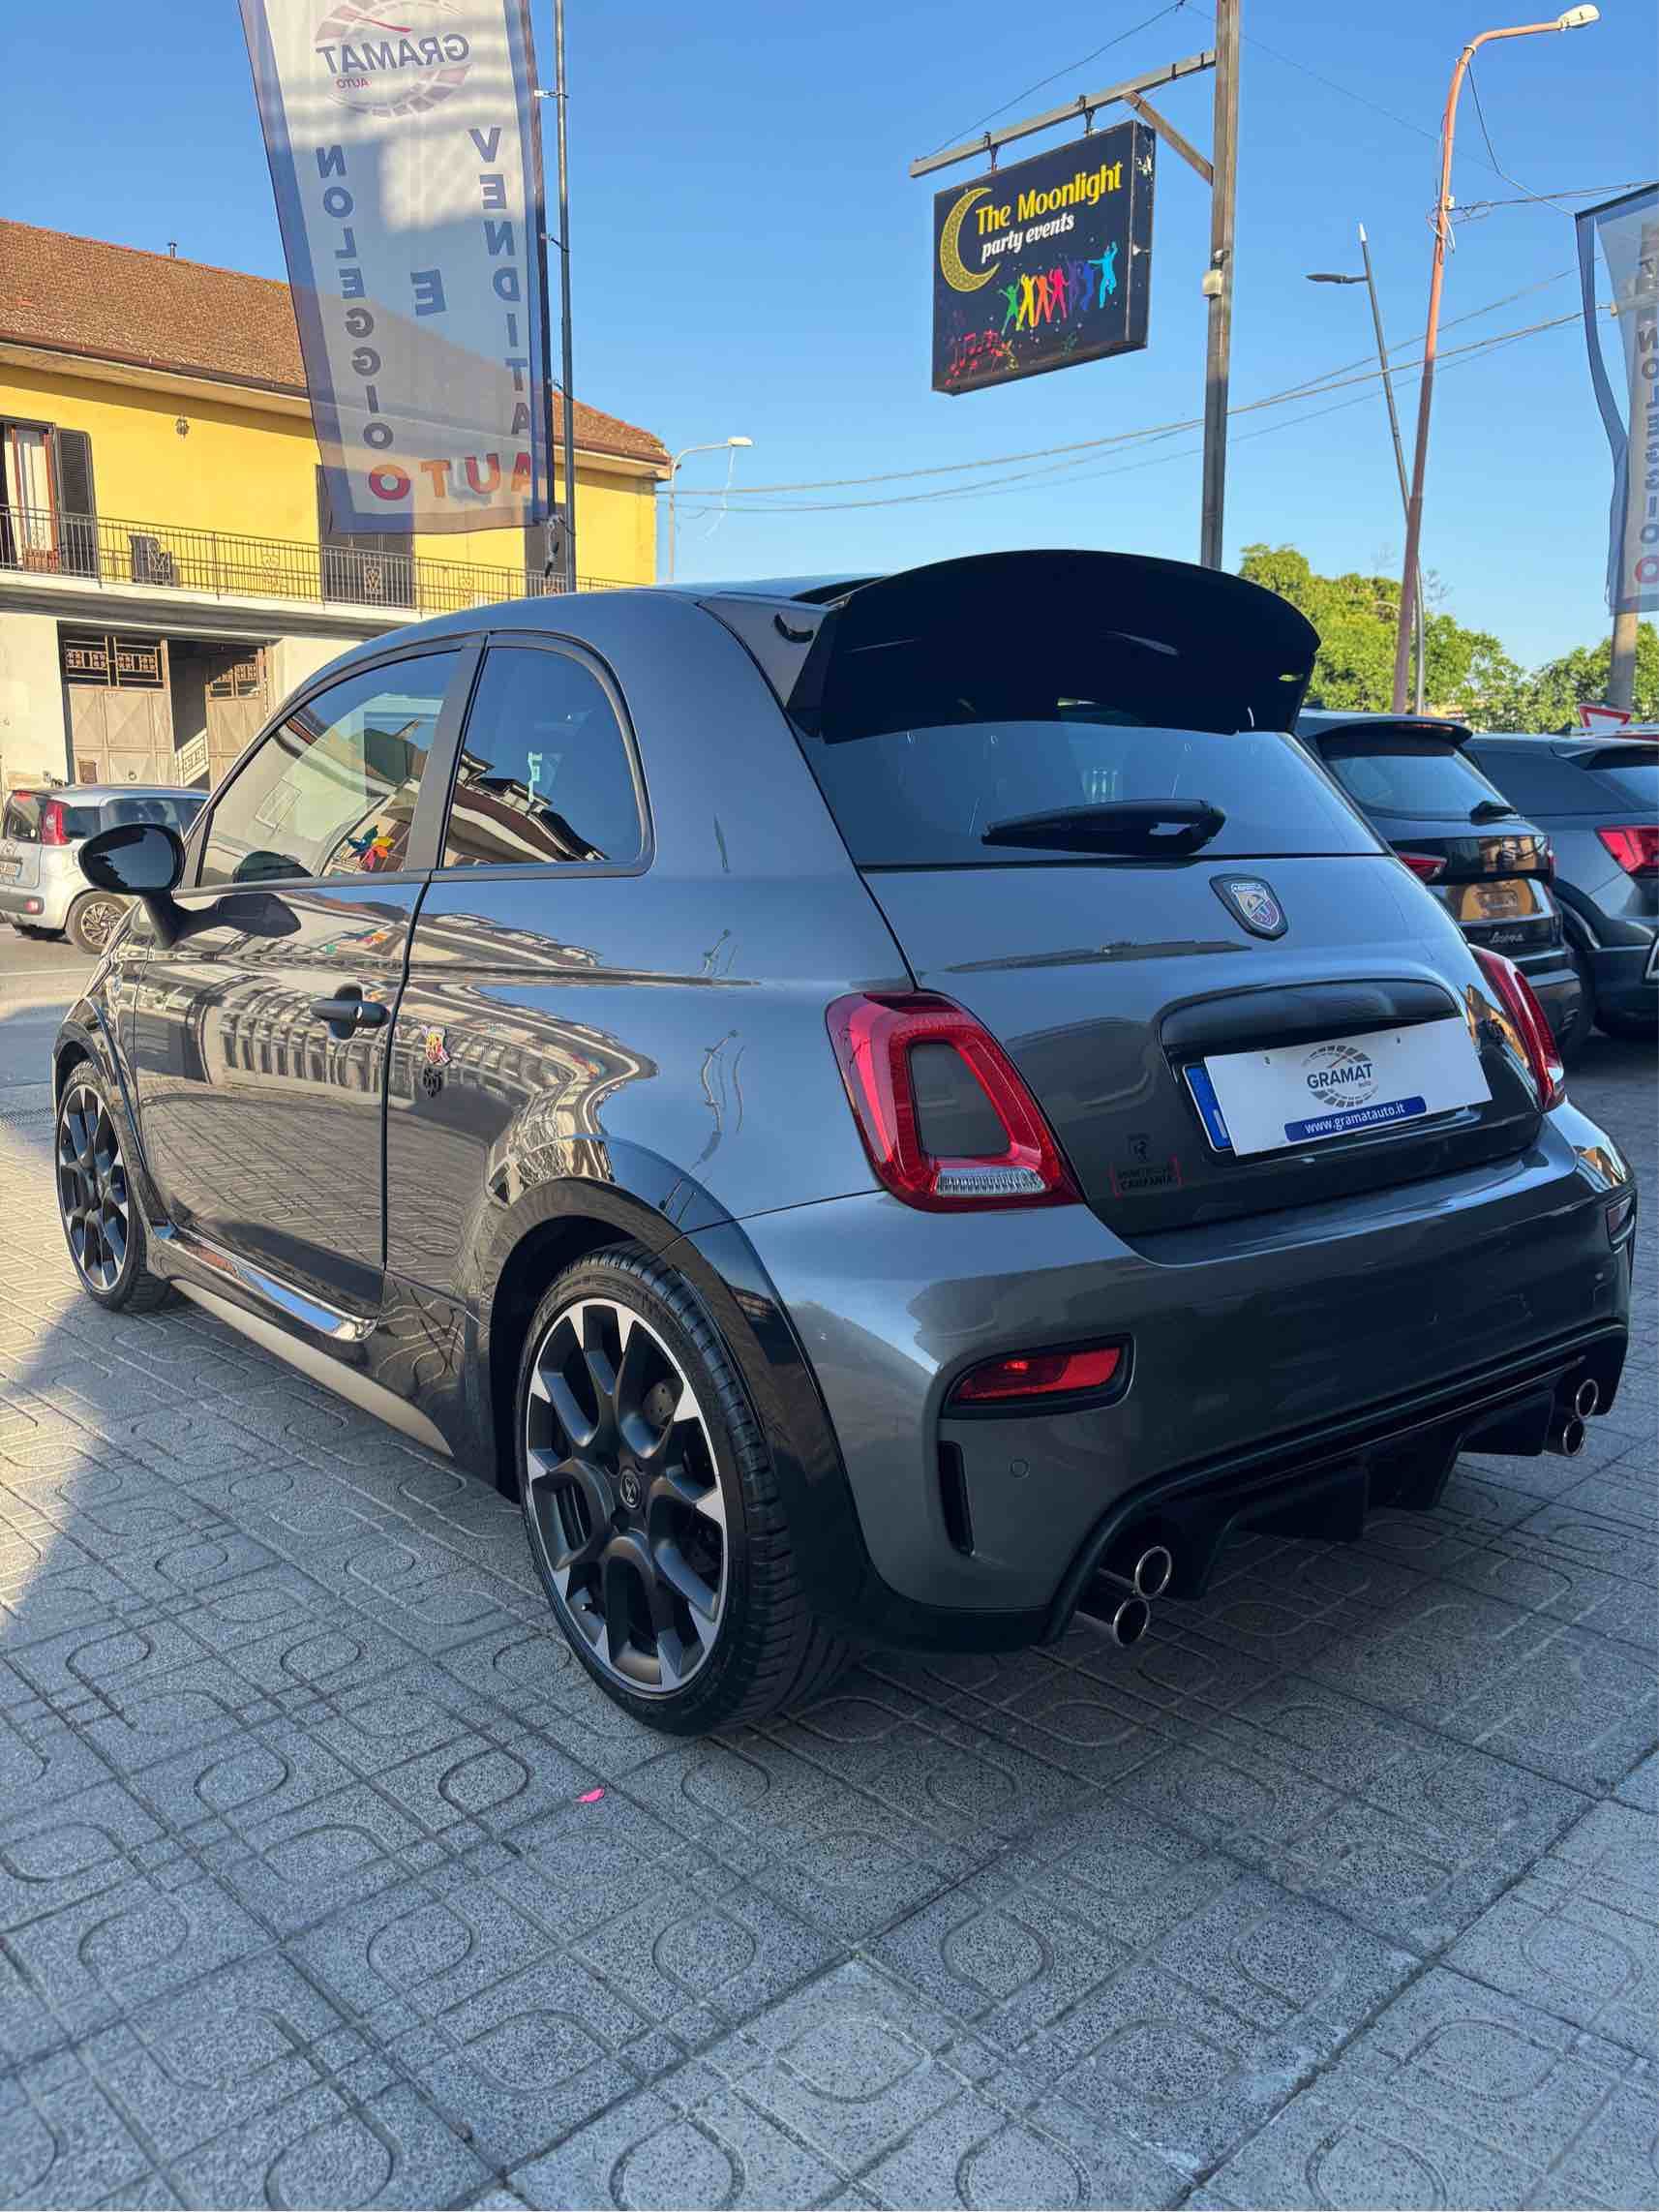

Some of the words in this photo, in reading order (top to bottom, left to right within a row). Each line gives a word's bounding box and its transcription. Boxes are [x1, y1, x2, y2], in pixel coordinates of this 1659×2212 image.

[976, 203, 1010, 235] The
[1017, 160, 1124, 223] Moonlight
[980, 228, 1023, 264] party
[1026, 212, 1075, 245] events
[1307, 1063, 1372, 1089] GRAMAT
[1305, 1102, 1405, 1135] www.gramatauto.it
